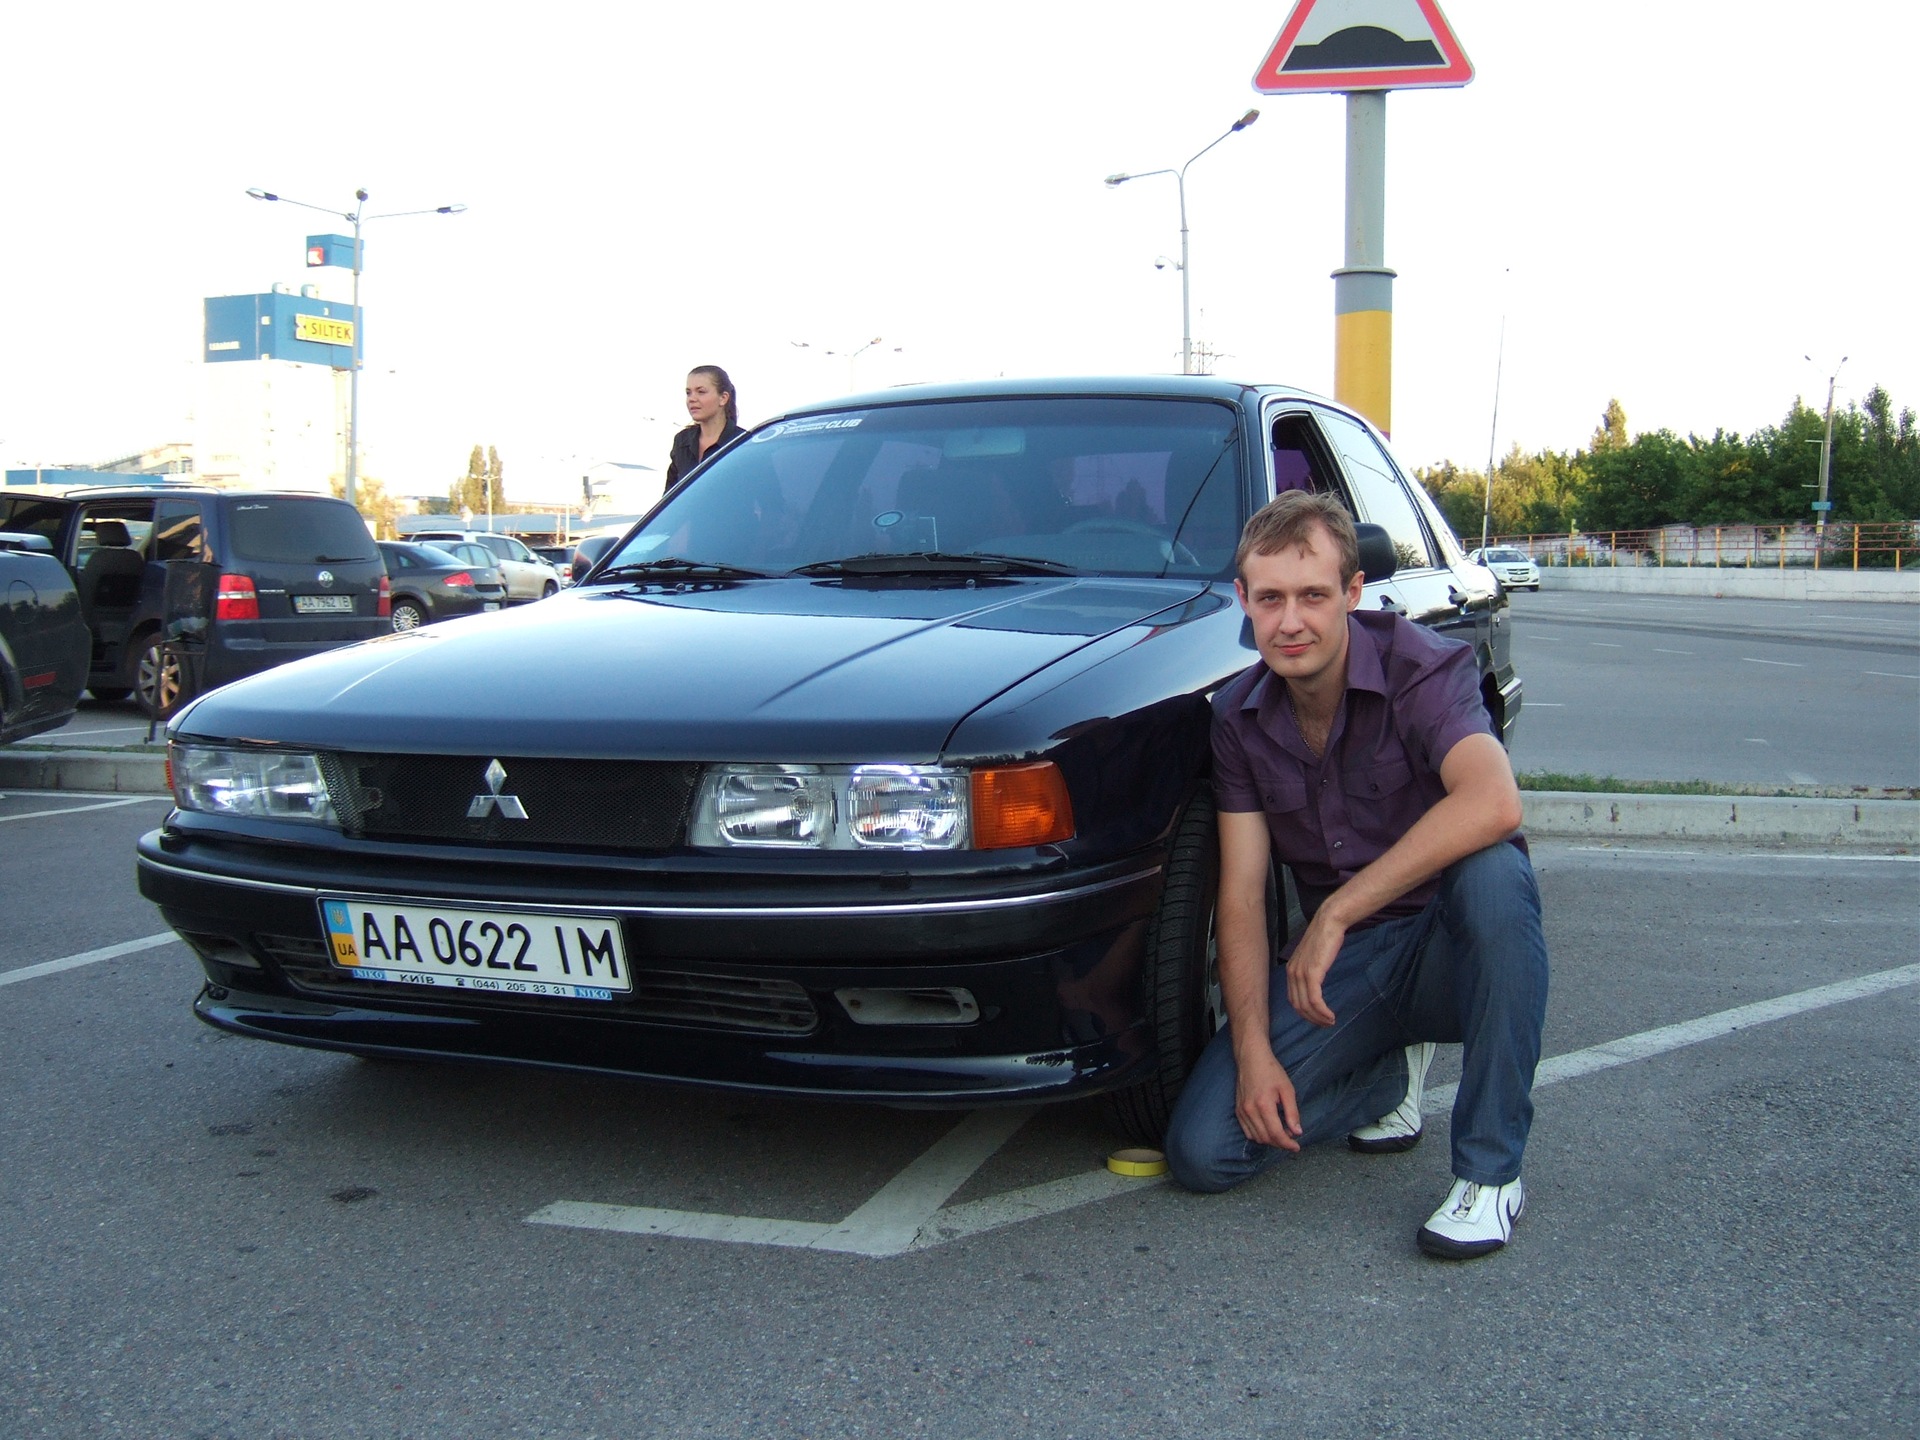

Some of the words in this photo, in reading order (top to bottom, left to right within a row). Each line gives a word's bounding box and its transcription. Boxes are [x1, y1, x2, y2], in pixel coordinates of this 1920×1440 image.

[311, 322, 352, 340] SILTEK
[826, 419, 863, 429] CLUB
[302, 597, 315, 608] AA
[338, 942, 357, 957] UA
[363, 912, 423, 963] AA
[429, 917, 538, 972] 0622
[554, 925, 619, 978] IM
[354, 969, 384, 980] NIKO
[400, 973, 435, 985] КИЇВ
[473, 978, 500, 990] (044)
[506, 982, 527, 992] 205
[533, 984, 547, 994] 33
[553, 985, 567, 995] 31
[577, 987, 611, 999] NIKO
